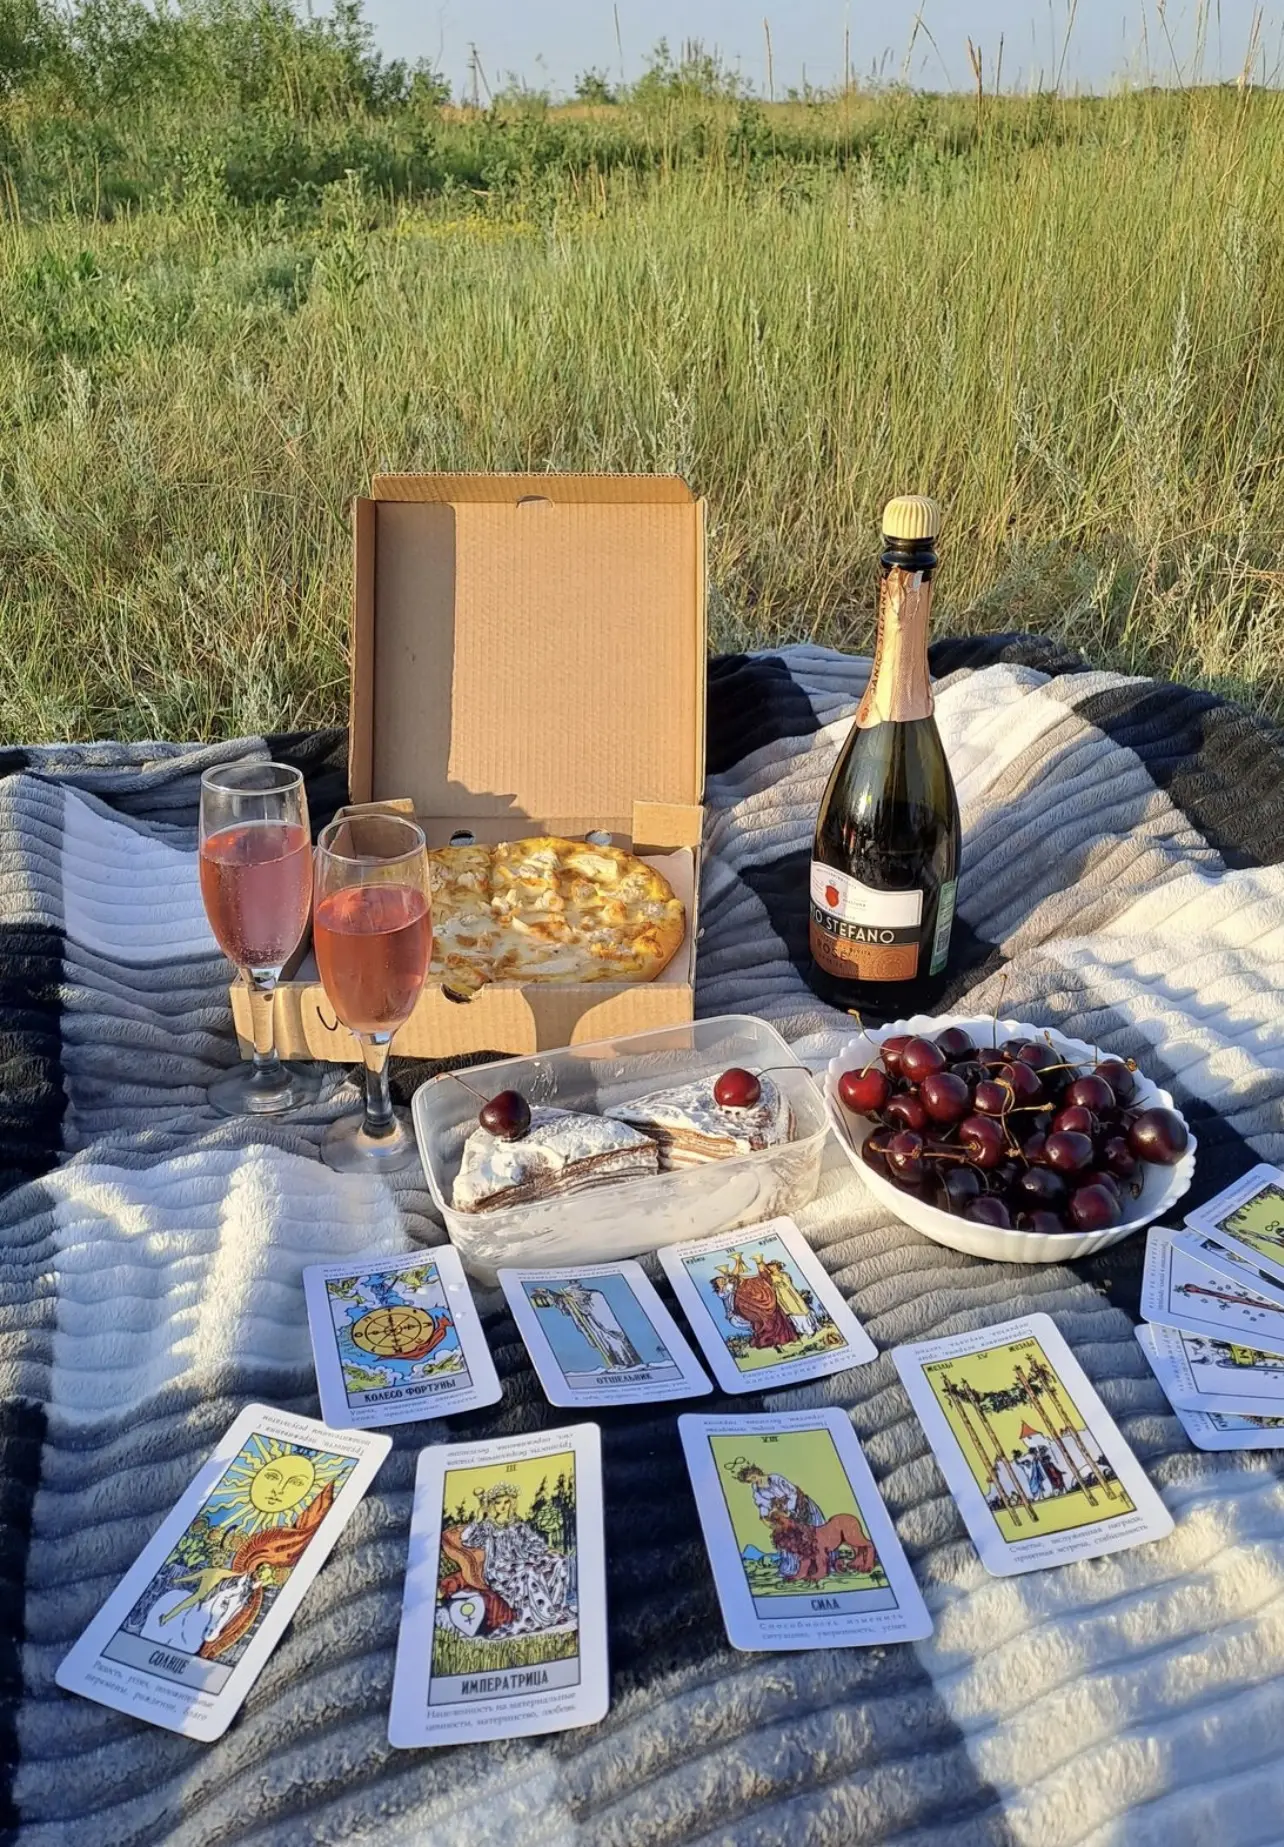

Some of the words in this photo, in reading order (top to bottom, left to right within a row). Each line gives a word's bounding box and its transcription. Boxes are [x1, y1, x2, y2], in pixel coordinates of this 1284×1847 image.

[826, 916, 895, 944] STEFANO
[364, 1390, 403, 1403] КОЛЕСО
[405, 1379, 456, 1396] ФОРТУНЫ
[596, 1373, 654, 1385] ОТШЕЛЬНИК
[810, 1598, 841, 1612] СИЛА
[148, 1650, 190, 1675] СОЛНЦЕ
[461, 1669, 549, 1696] ИМПЕРАТРИЦА
